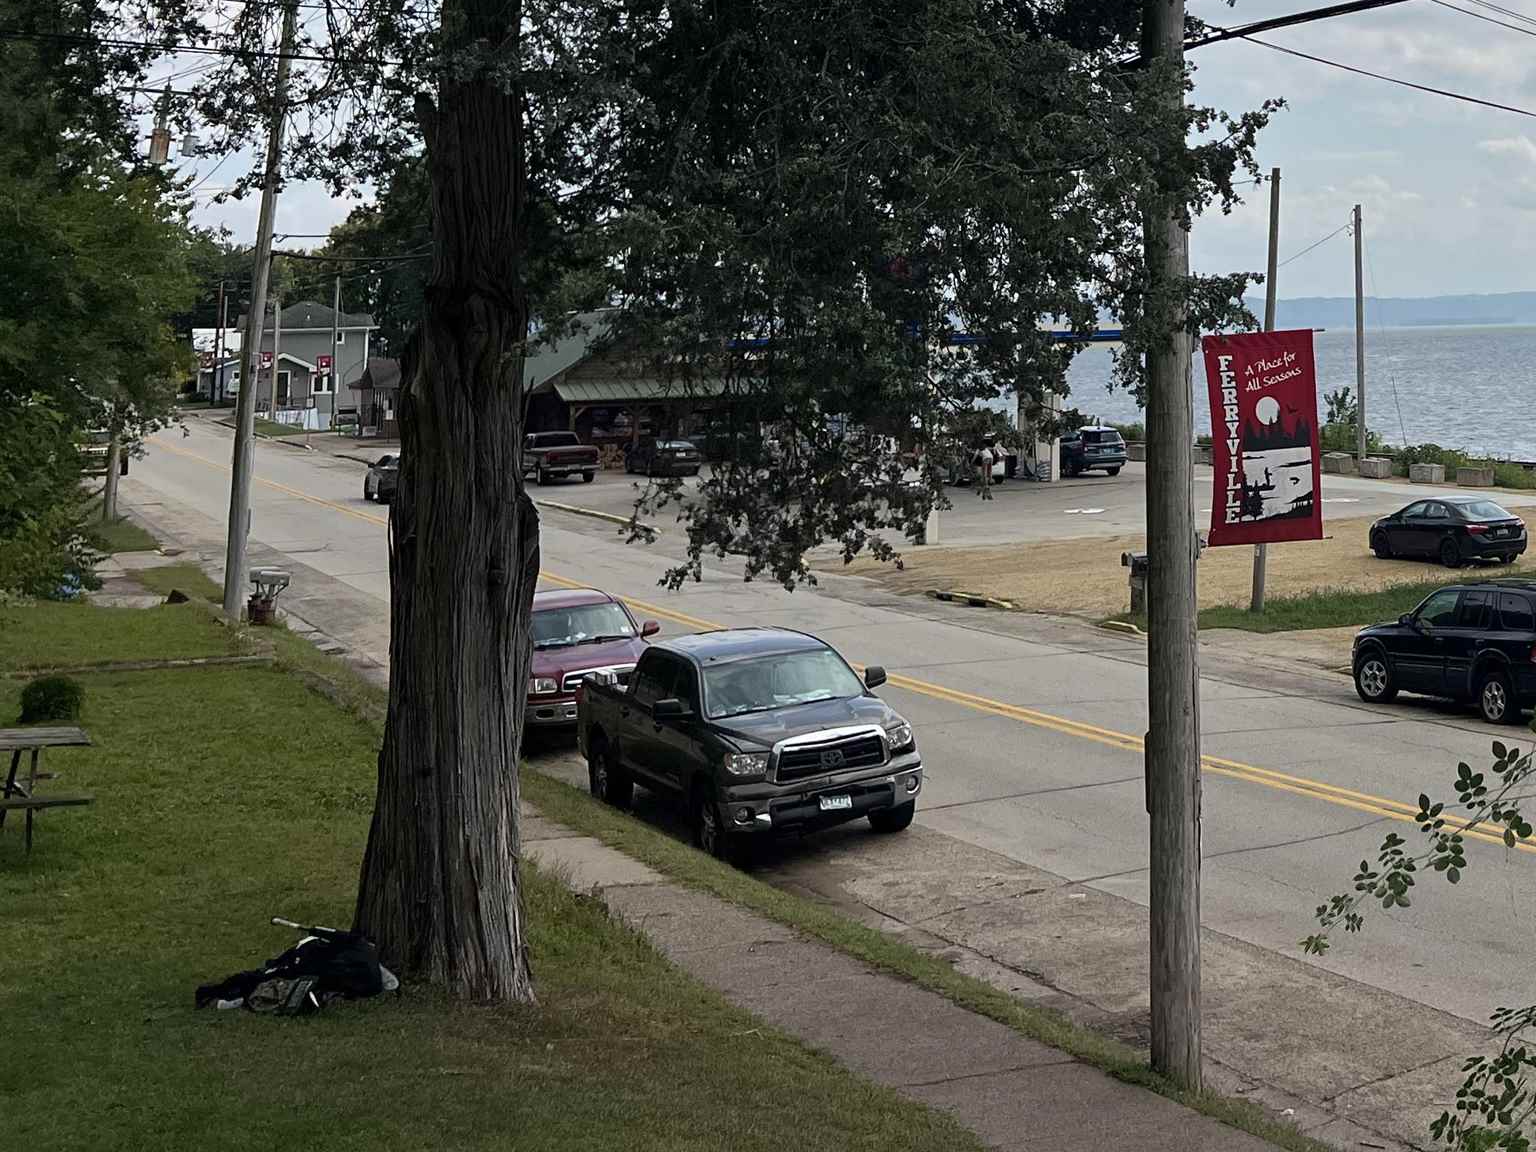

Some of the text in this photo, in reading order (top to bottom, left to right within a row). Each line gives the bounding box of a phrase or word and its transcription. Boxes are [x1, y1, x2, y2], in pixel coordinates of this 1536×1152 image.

[1244, 351, 1297, 378] A Place for
[1245, 367, 1303, 393] All Seasons
[1218, 355, 1241, 524] FERRYVILLE
